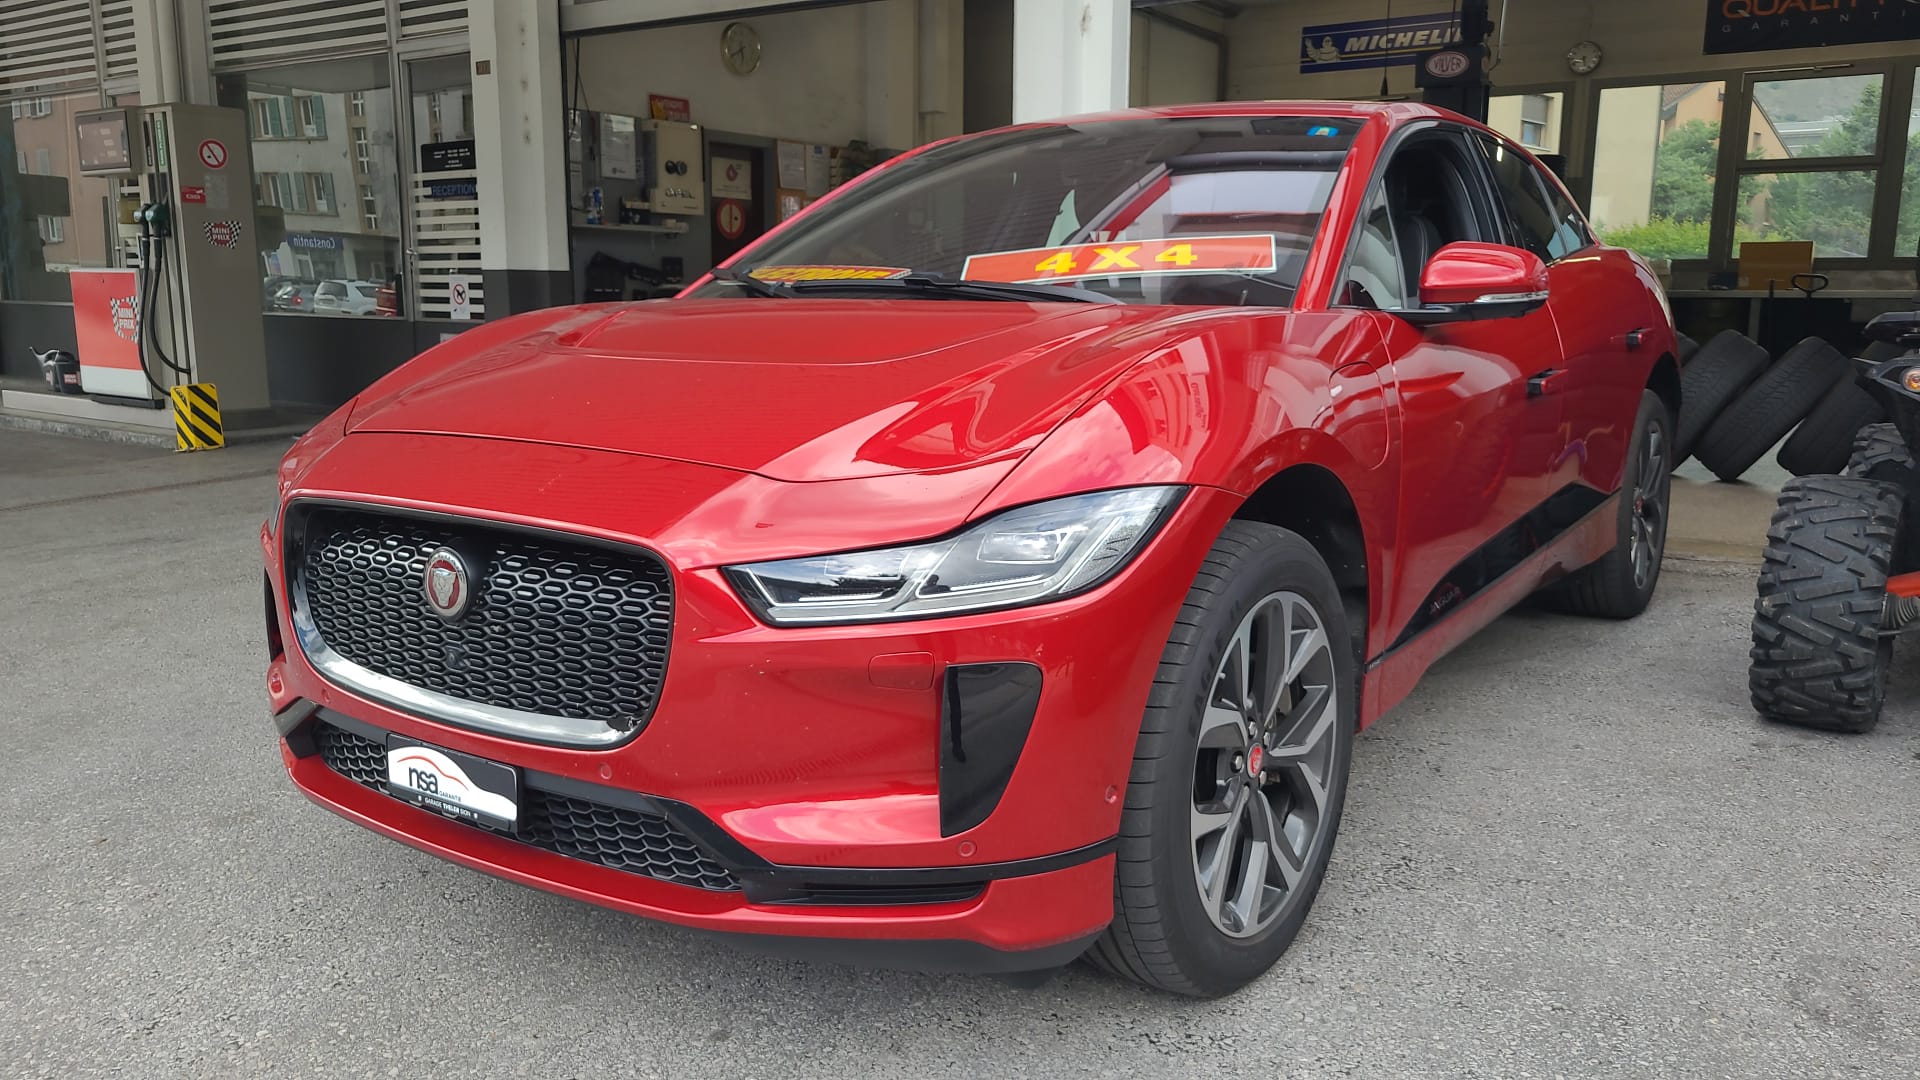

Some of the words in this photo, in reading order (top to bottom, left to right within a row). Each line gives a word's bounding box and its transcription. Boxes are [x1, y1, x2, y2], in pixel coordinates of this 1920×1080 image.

[117, 307, 134, 318] MINI
[119, 319, 135, 330] PRIX
[409, 766, 438, 794] nsa
